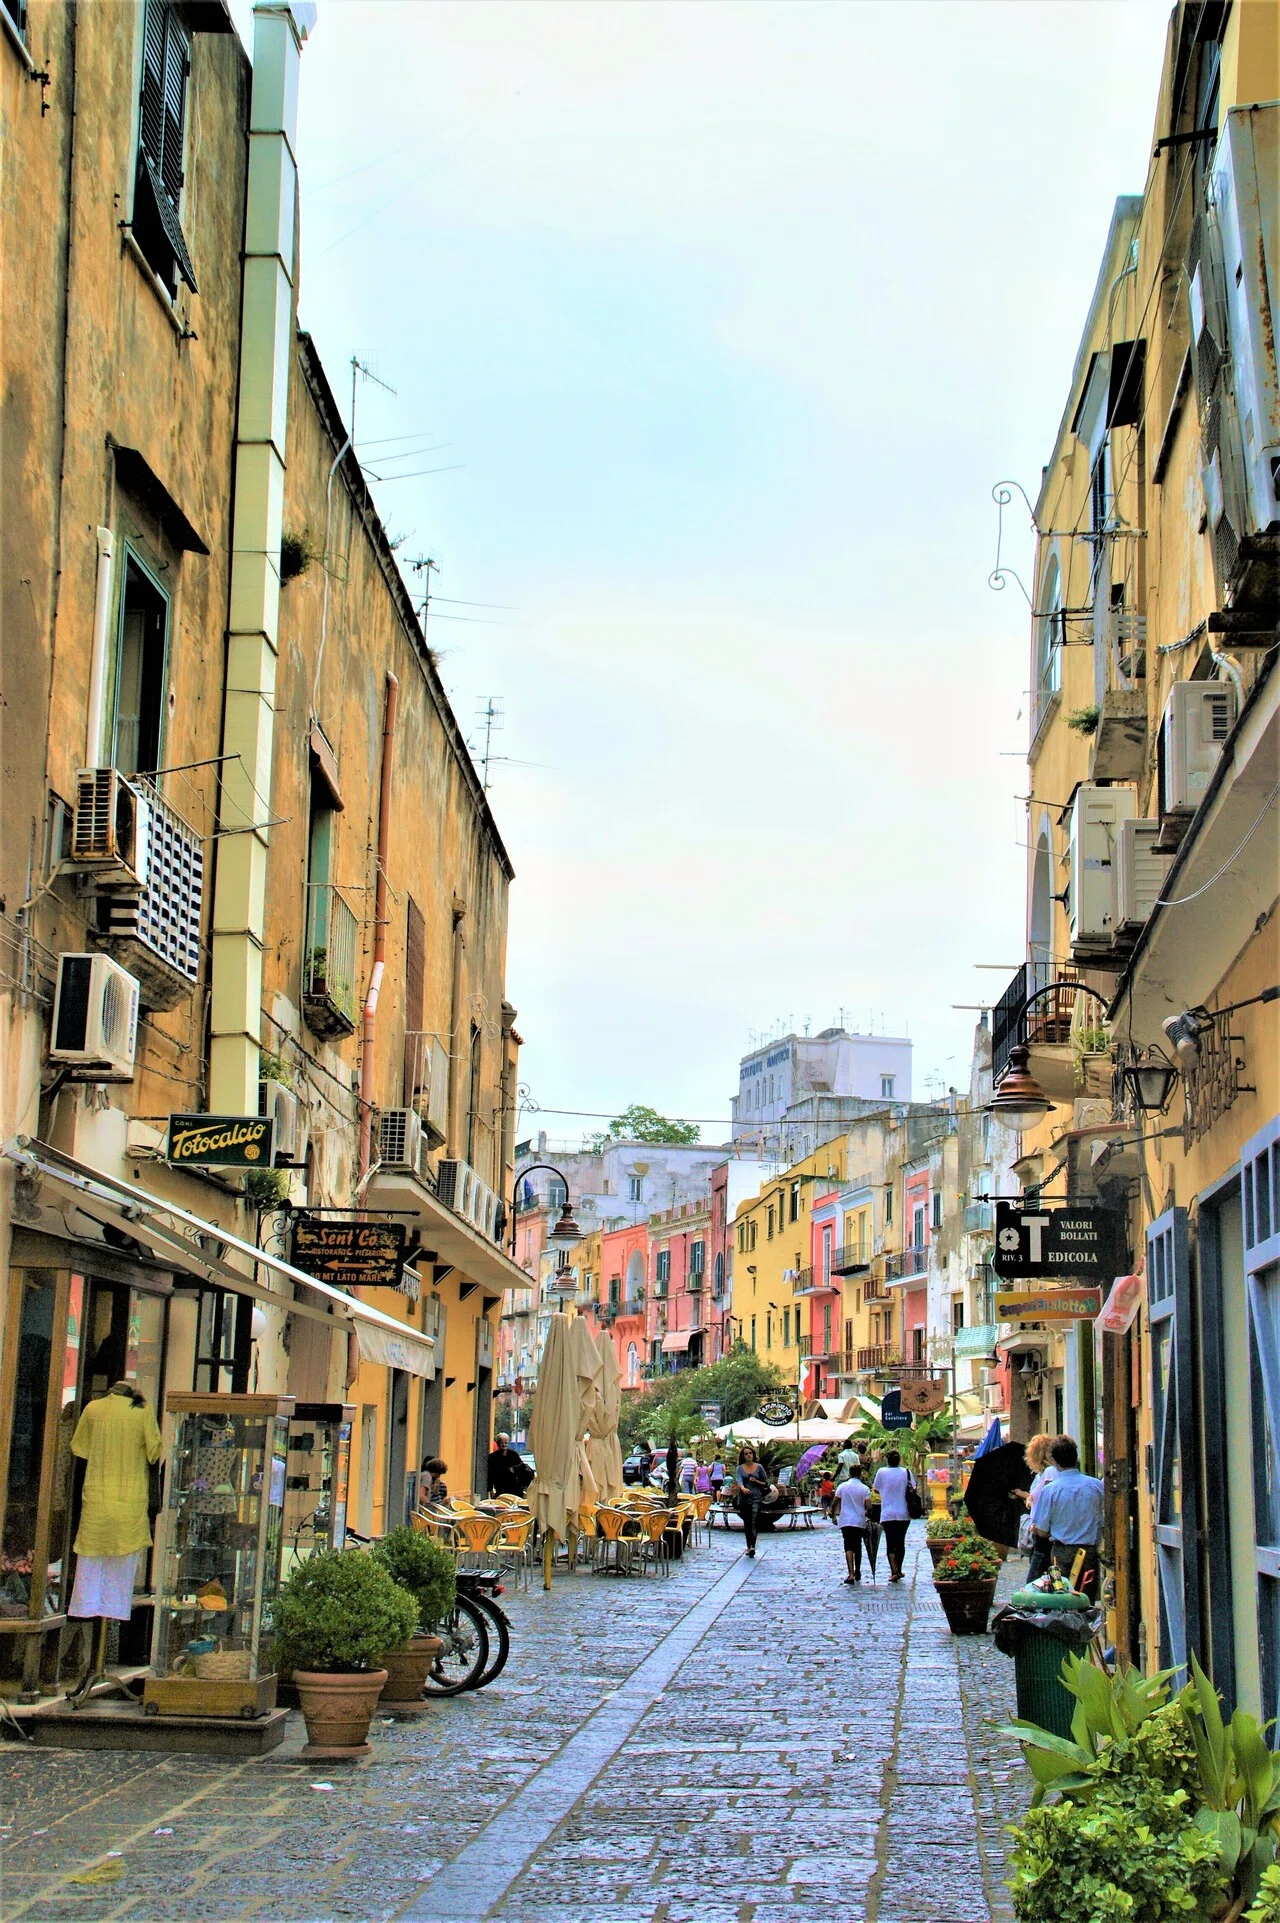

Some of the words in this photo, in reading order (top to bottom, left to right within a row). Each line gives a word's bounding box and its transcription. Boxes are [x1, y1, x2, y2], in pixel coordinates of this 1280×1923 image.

[173, 1121, 266, 1159] Totocalcio
[1060, 1221, 1093, 1230] VALORI
[1021, 1216, 1050, 1263] T
[1060, 1232, 1098, 1241] BOLLATI
[311, 1248, 352, 1256] RISTORANTE
[1002, 1254, 1017, 1262] RIV.
[1018, 1254, 1023, 1262] 3
[1048, 1252, 1098, 1263] EDICOLA
[322, 1272, 335, 1281] MT
[337, 1273, 357, 1281] LATO
[359, 1274, 382, 1282] MARE
